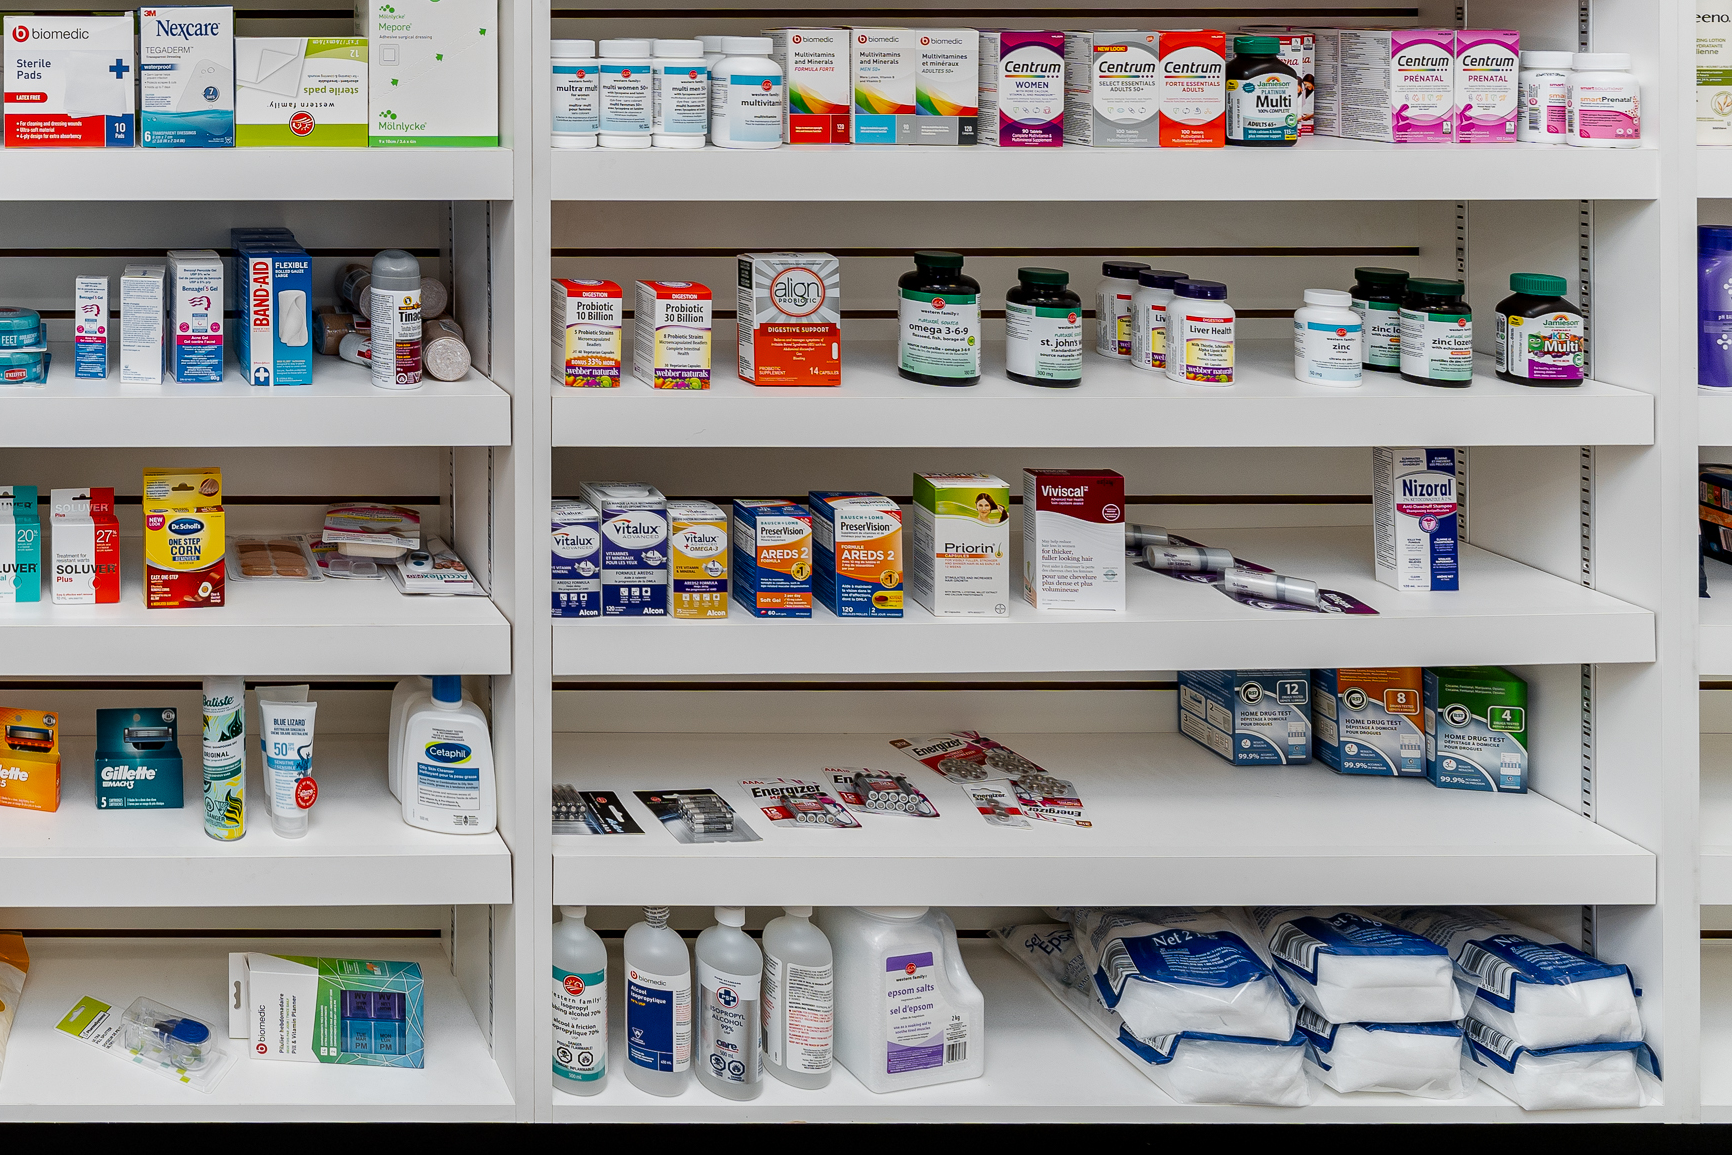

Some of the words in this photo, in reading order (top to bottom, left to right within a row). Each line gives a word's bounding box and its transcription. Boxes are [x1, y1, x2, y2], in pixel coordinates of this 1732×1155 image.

[32, 28, 89, 40] biomedic
[156, 20, 219, 40] Nexcare
[17, 59, 51, 69] Sterile
[1398, 55, 1449, 67] Centrum
[1005, 61, 1060, 73] Centrum
[17, 70, 41, 80] Pads
[1404, 74, 1444, 82] PRÉNATAL
[1256, 95, 1292, 108] Multi
[379, 121, 426, 133] Mölnlycke
[775, 279, 820, 306] align
[577, 301, 613, 311] Probiotic
[576, 312, 585, 320] 10
[587, 311, 613, 320] Billion
[909, 324, 942, 334] omega
[1042, 486, 1085, 497] Viviscal
[1402, 479, 1452, 497] Nizoral
[613, 522, 662, 534] vitalux
[170, 545, 201, 555] CORN
[945, 542, 994, 553] Priorin
[761, 550, 798, 559] AREDS
[801, 548, 809, 558] 2
[1287, 685, 1299, 694] 12
[274, 718, 286, 726] BLUE
[274, 743, 287, 756] 50
[430, 747, 466, 758] Cetaphil
[101, 767, 156, 781] Gillette
[888, 986, 912, 999] epsom
[915, 983, 934, 993] salts
